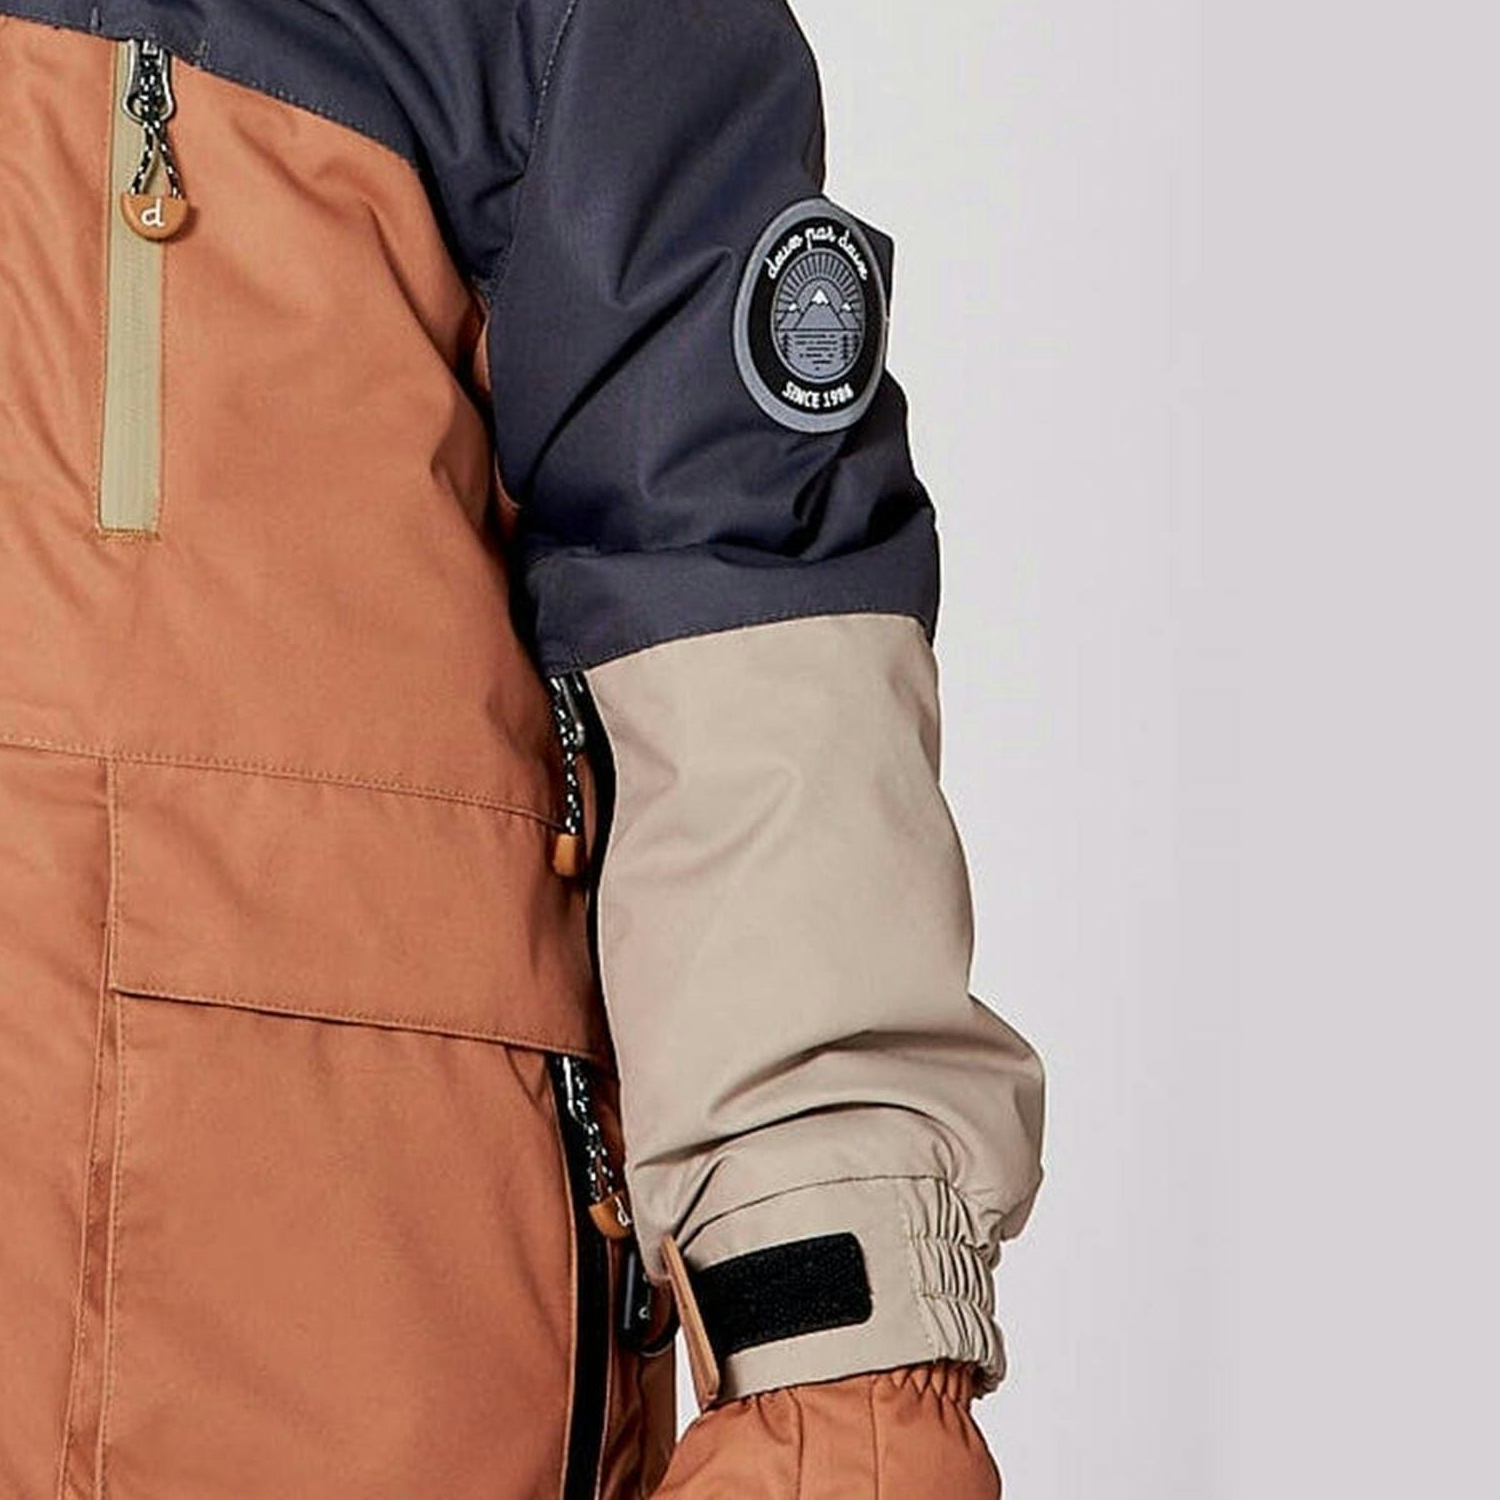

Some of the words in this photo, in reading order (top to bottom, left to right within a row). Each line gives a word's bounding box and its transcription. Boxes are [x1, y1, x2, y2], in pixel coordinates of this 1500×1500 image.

[141, 199, 164, 227] d
[804, 226, 836, 250] par
[781, 381, 820, 409] SINCE
